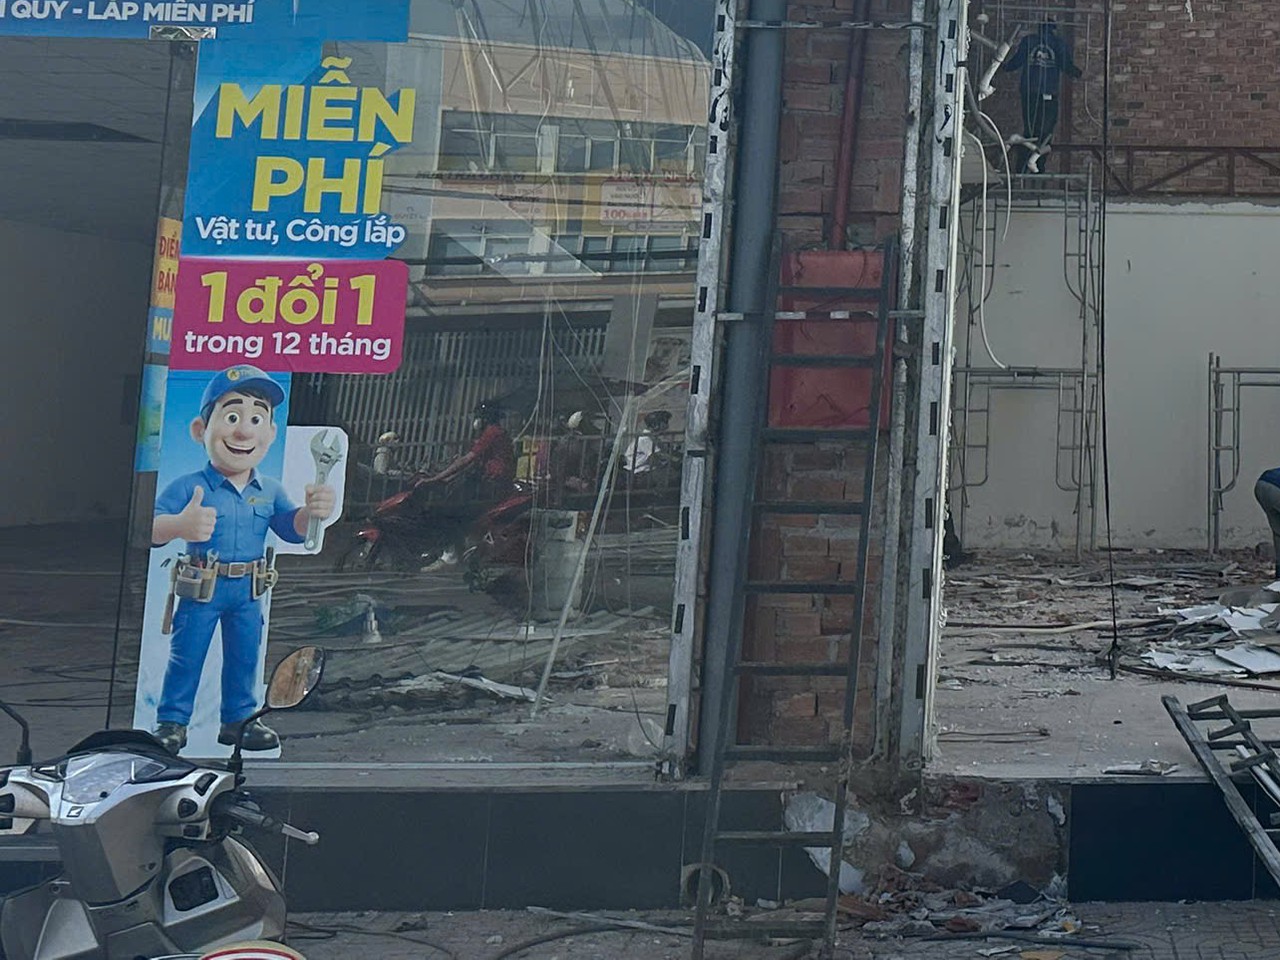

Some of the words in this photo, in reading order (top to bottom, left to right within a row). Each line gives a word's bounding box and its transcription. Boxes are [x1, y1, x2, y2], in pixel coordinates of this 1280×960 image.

[11, 0, 69, 20] QUY
[211, 0, 256, 23] PHÍ
[216, 56, 416, 143] MIỄN
[252, 142, 392, 214] PHÍ
[195, 216, 240, 245] Vật
[245, 218, 279, 244] tư,
[286, 216, 359, 247] Công
[364, 214, 406, 247] lắp
[201, 271, 228, 323] 1
[236, 262, 339, 326] đổi
[349, 274, 376, 325] 1
[185, 331, 263, 358] trong
[272, 331, 301, 355] 12
[309, 331, 391, 361] tháng
